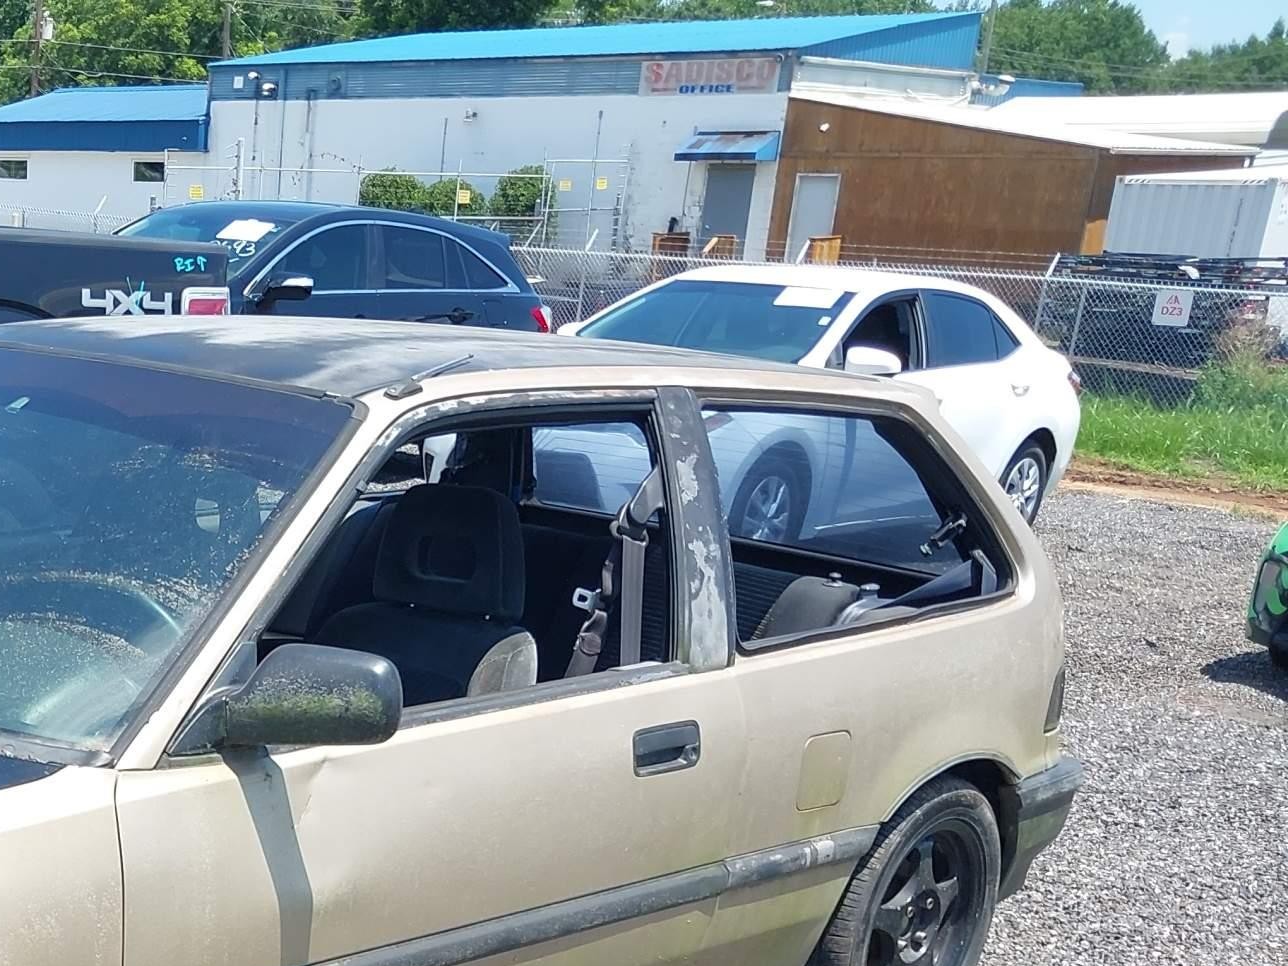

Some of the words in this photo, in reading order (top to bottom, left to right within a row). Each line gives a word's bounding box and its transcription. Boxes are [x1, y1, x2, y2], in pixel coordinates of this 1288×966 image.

[645, 60, 777, 83] SADISCO
[679, 84, 736, 94] OFFICE
[1161, 306, 1183, 316] DZ3
